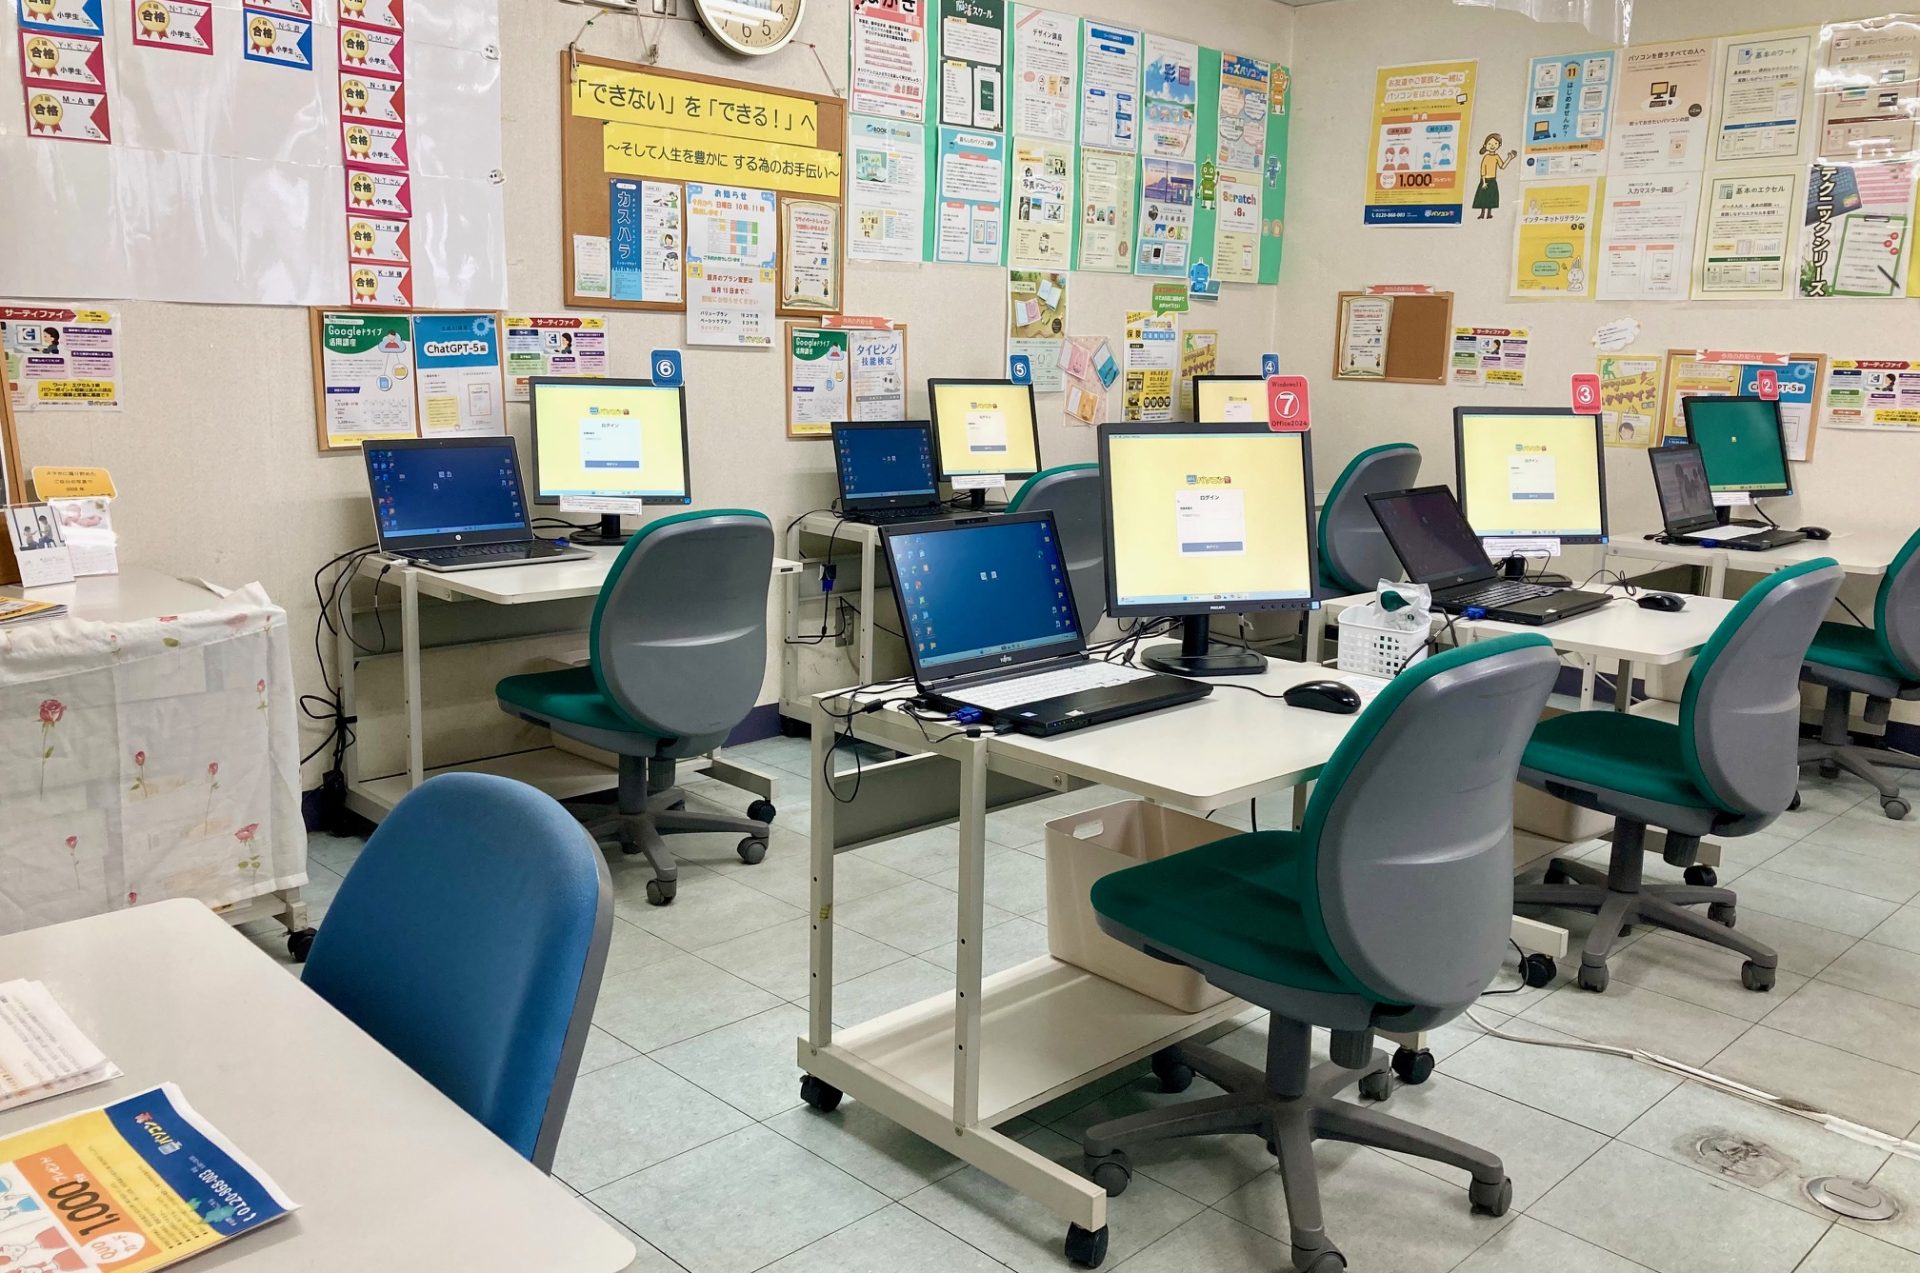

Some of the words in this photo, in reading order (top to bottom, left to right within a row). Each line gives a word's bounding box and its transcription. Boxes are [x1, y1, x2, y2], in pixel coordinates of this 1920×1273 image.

[57, 12, 80, 21] 小学生
[142, 10, 166, 23] 合格
[252, 26, 273, 39] 合格
[742, 23, 752, 37] 6
[762, 19, 772, 36] 5
[170, 30, 192, 39] 小学生
[1033, 29, 1063, 41] デザイン講座
[276, 46, 294, 55] 小学生
[346, 38, 365, 51] 合格
[31, 47, 55, 60] 合格
[1628, 48, 1706, 61] パソコンを使うすべての人へ
[1755, 48, 1797, 59] 基本のワード
[368, 57, 387, 65] 小学生
[60, 67, 82, 76] 小学生
[1567, 68, 1576, 77] 11
[1388, 75, 1463, 88] お友達やご家族と一緒に
[345, 88, 365, 100] 合格
[34, 104, 59, 117] 合格
[1412, 113, 1428, 121] 特典
[349, 134, 368, 146] 合格
[371, 151, 390, 159] 小学生
[1023, 179, 1062, 191] 写真デコレーション
[1400, 173, 1432, 187] 1,000
[353, 182, 372, 193] 合格
[1627, 186, 1674, 195] 入力マスター講座
[1736, 186, 1784, 195] 基本のエクセル
[714, 189, 747, 200] お知らせ
[1222, 190, 1257, 206] Scratch
[375, 198, 393, 206] 小学生
[617, 191, 632, 259] カスハラ
[1523, 216, 1587, 224] インターネットリテラシー
[353, 231, 372, 242] 合格
[1810, 167, 1838, 297] テクニックシリーズ
[356, 278, 375, 289] 合格
[5, 309, 64, 318] サーティファイ
[328, 325, 383, 338] Googleドライブ
[329, 338, 357, 346] 活用講座
[795, 337, 831, 347] Googleドライブ
[857, 344, 897, 356] タイピング
[861, 357, 893, 366] 技能検定
[659, 361, 673, 376] 6
[1015, 364, 1024, 376] 5
[1762, 380, 1772, 392] 2
[1579, 386, 1592, 402] 3
[1279, 393, 1295, 415] 7
[47, 1180, 121, 1237] 1,000
[93, 1240, 119, 1260] QUO
